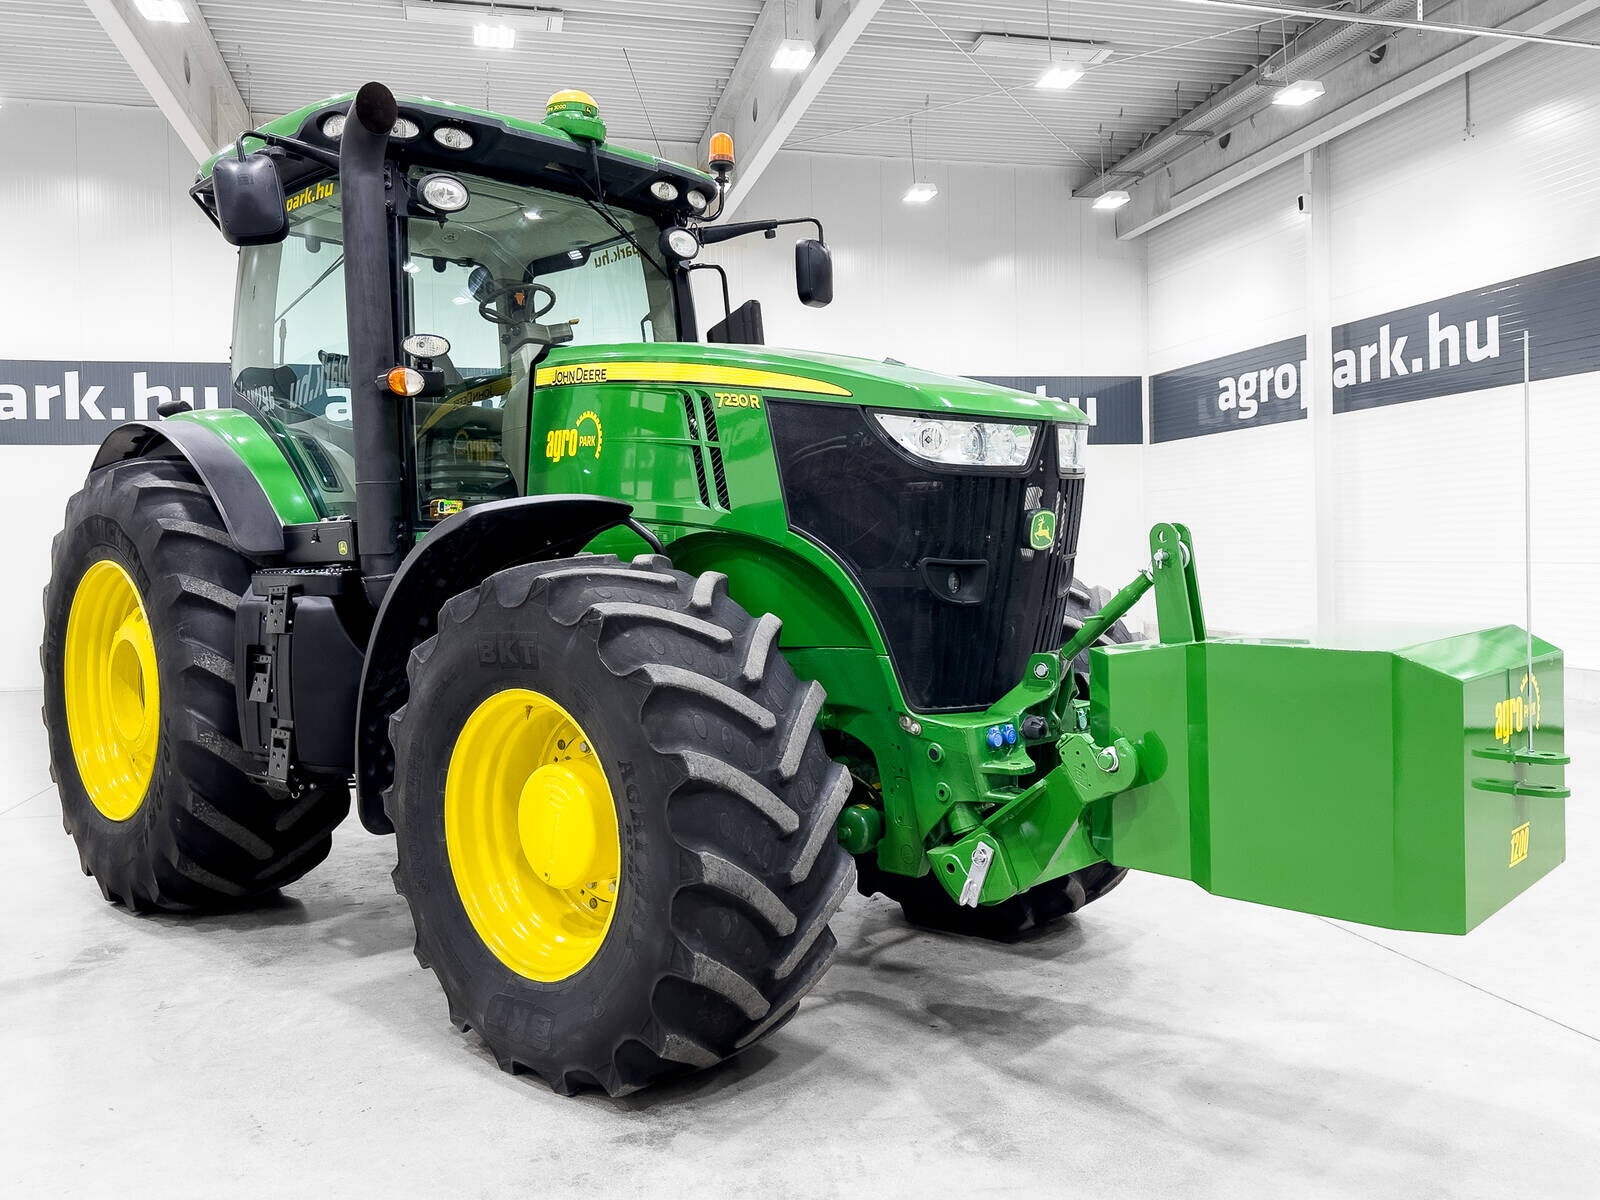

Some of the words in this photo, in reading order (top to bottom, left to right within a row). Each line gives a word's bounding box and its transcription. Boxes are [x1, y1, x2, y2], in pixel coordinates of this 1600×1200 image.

[714, 392, 748, 408] 7230
[749, 394, 761, 409] R
[545, 428, 578, 463] agro
[579, 435, 597, 447] PARK
[479, 639, 536, 665] BKT
[1495, 696, 1523, 745] agro
[1510, 826, 1530, 863] 1200
